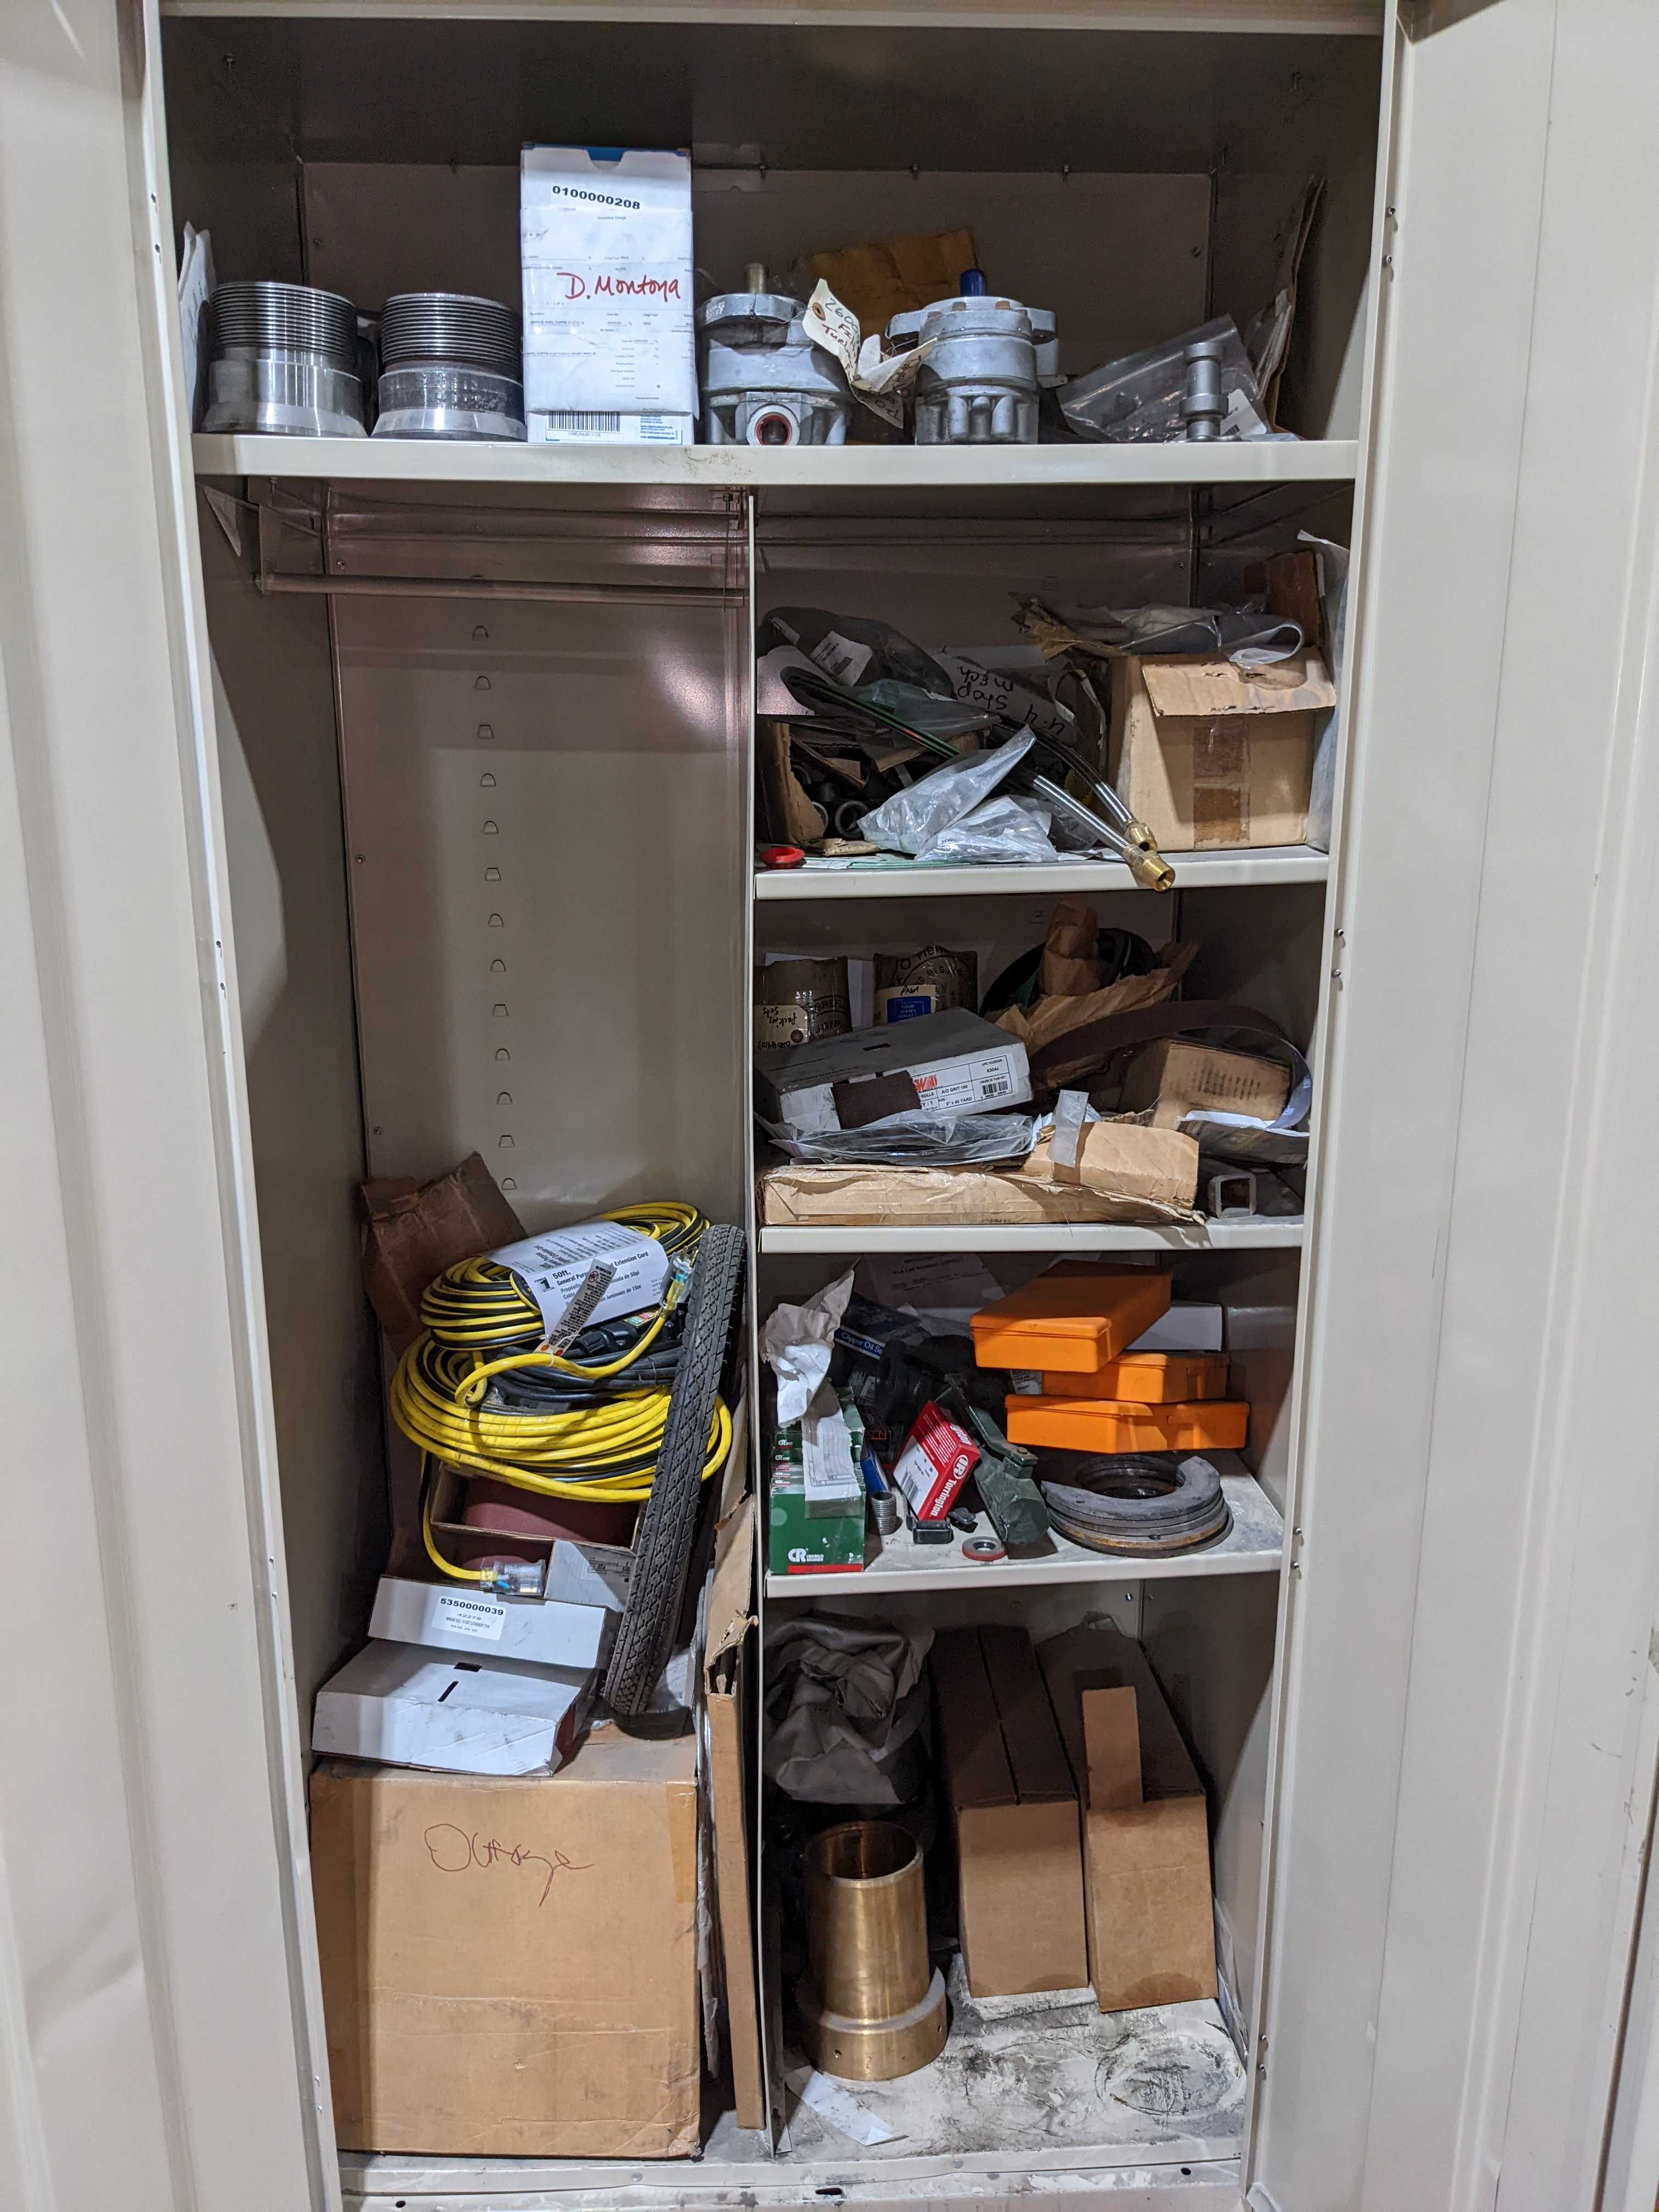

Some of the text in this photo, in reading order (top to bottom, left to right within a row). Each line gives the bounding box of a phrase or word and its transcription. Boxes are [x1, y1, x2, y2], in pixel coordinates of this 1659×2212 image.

[552, 185, 641, 210] 0100000208
[556, 272, 681, 303] D. Montoya
[552, 1268, 572, 1280] 50ft.
[556, 1274, 577, 1286] General
[615, 1256, 637, 1266] Extension
[636, 1251, 649, 1260] Cord
[841, 1331, 864, 1347] Clipper
[864, 1341, 874, 1351] Oil
[929, 1479, 957, 1517] Torrington
[788, 1548, 806, 1562] CR
[439, 1598, 505, 1616] 5350000039
